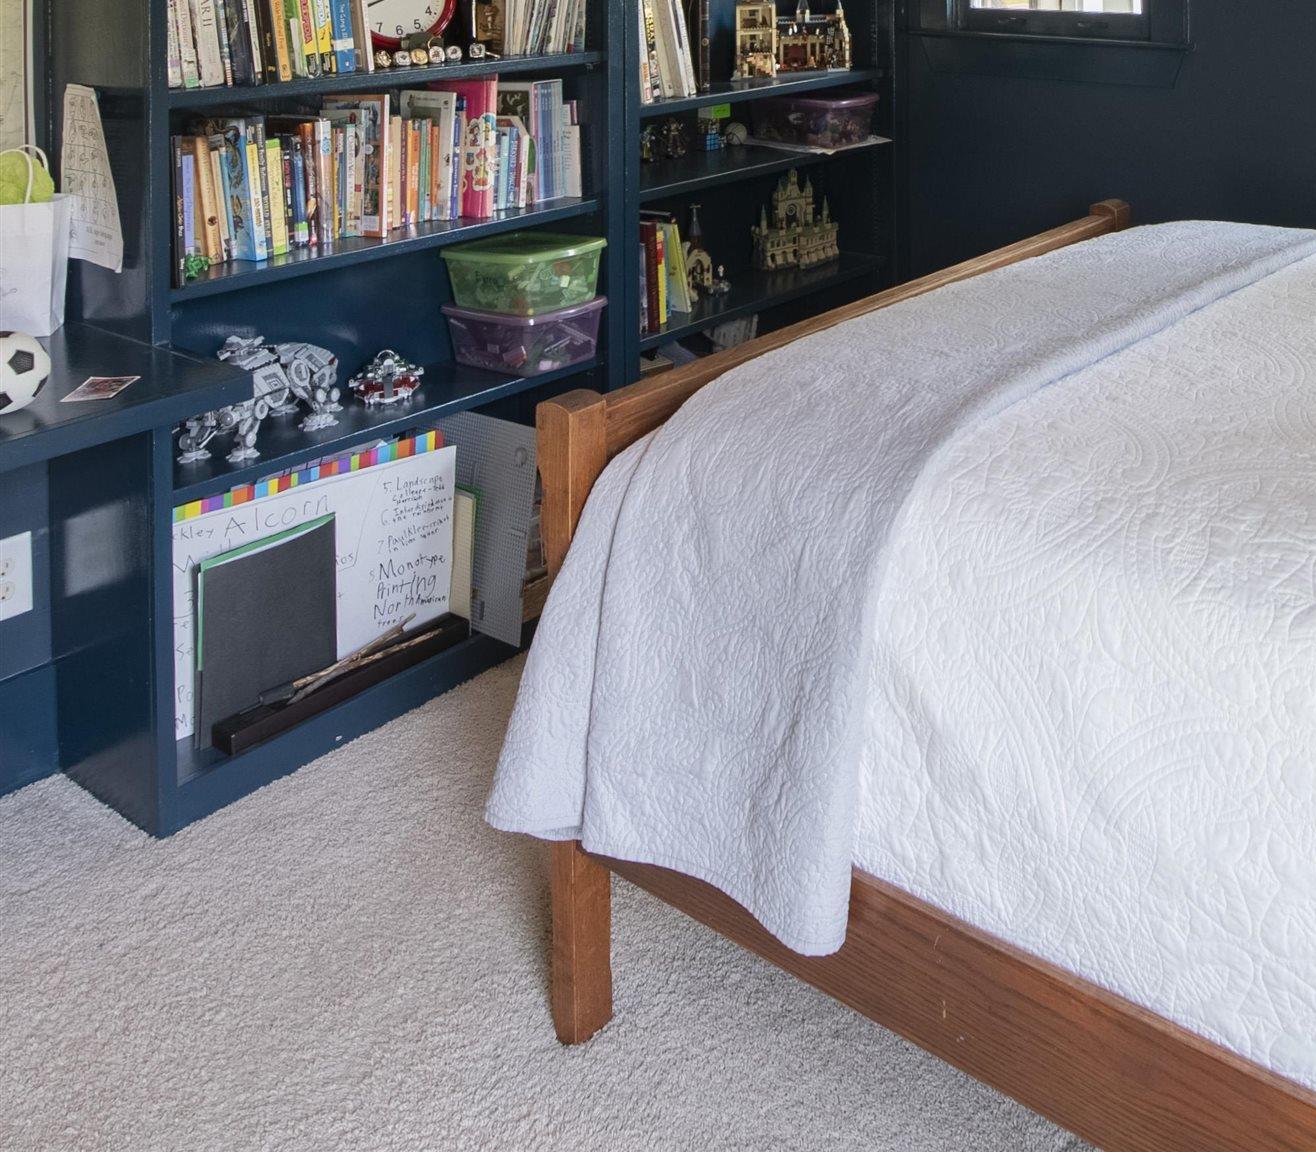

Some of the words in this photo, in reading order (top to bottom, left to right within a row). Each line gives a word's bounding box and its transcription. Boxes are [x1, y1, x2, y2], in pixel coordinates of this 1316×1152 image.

[425, 6, 433, 16] 4
[203, 18, 212, 27] II
[376, 22, 383, 33] 7
[414, 19, 422, 30] 5
[396, 25, 403, 35] 6
[396, 474, 443, 491] Landscape
[223, 494, 329, 537] Alcorn
[380, 553, 446, 581] Monotype
[377, 571, 436, 600] Printing
